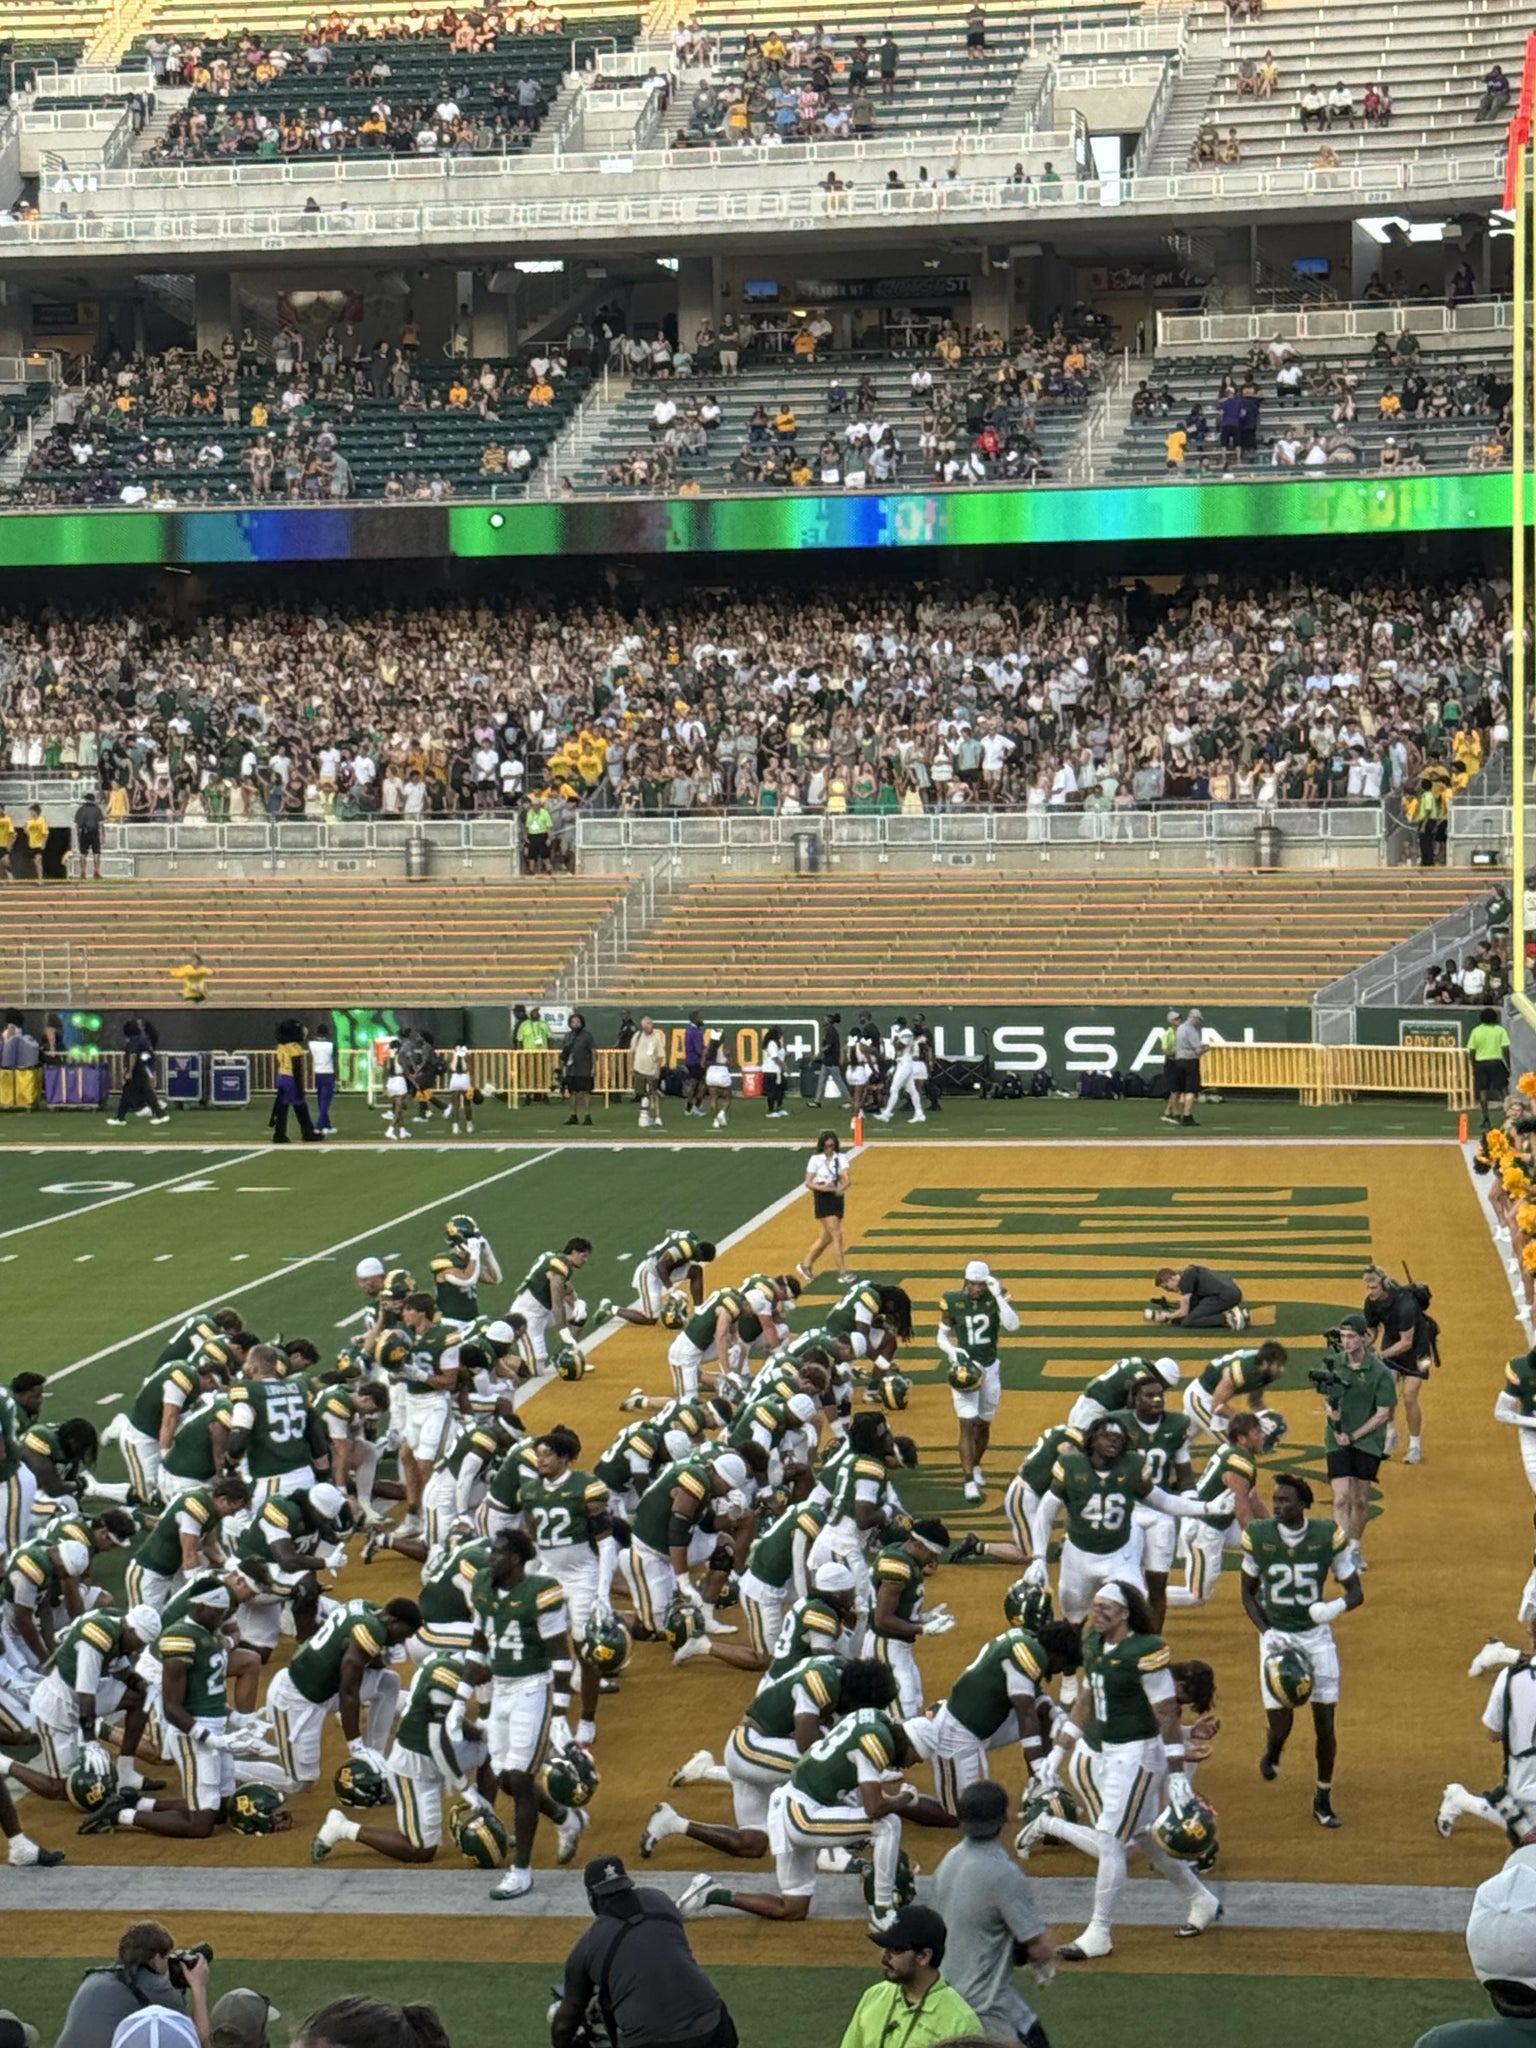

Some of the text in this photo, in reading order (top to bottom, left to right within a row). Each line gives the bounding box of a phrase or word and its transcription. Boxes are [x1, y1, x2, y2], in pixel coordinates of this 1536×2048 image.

[965, 1313, 992, 1346] 12
[266, 1395, 307, 1443] 55
[532, 1507, 573, 1547] 22
[1080, 1492, 1126, 1531] 46
[1267, 1562, 1319, 1606] 25
